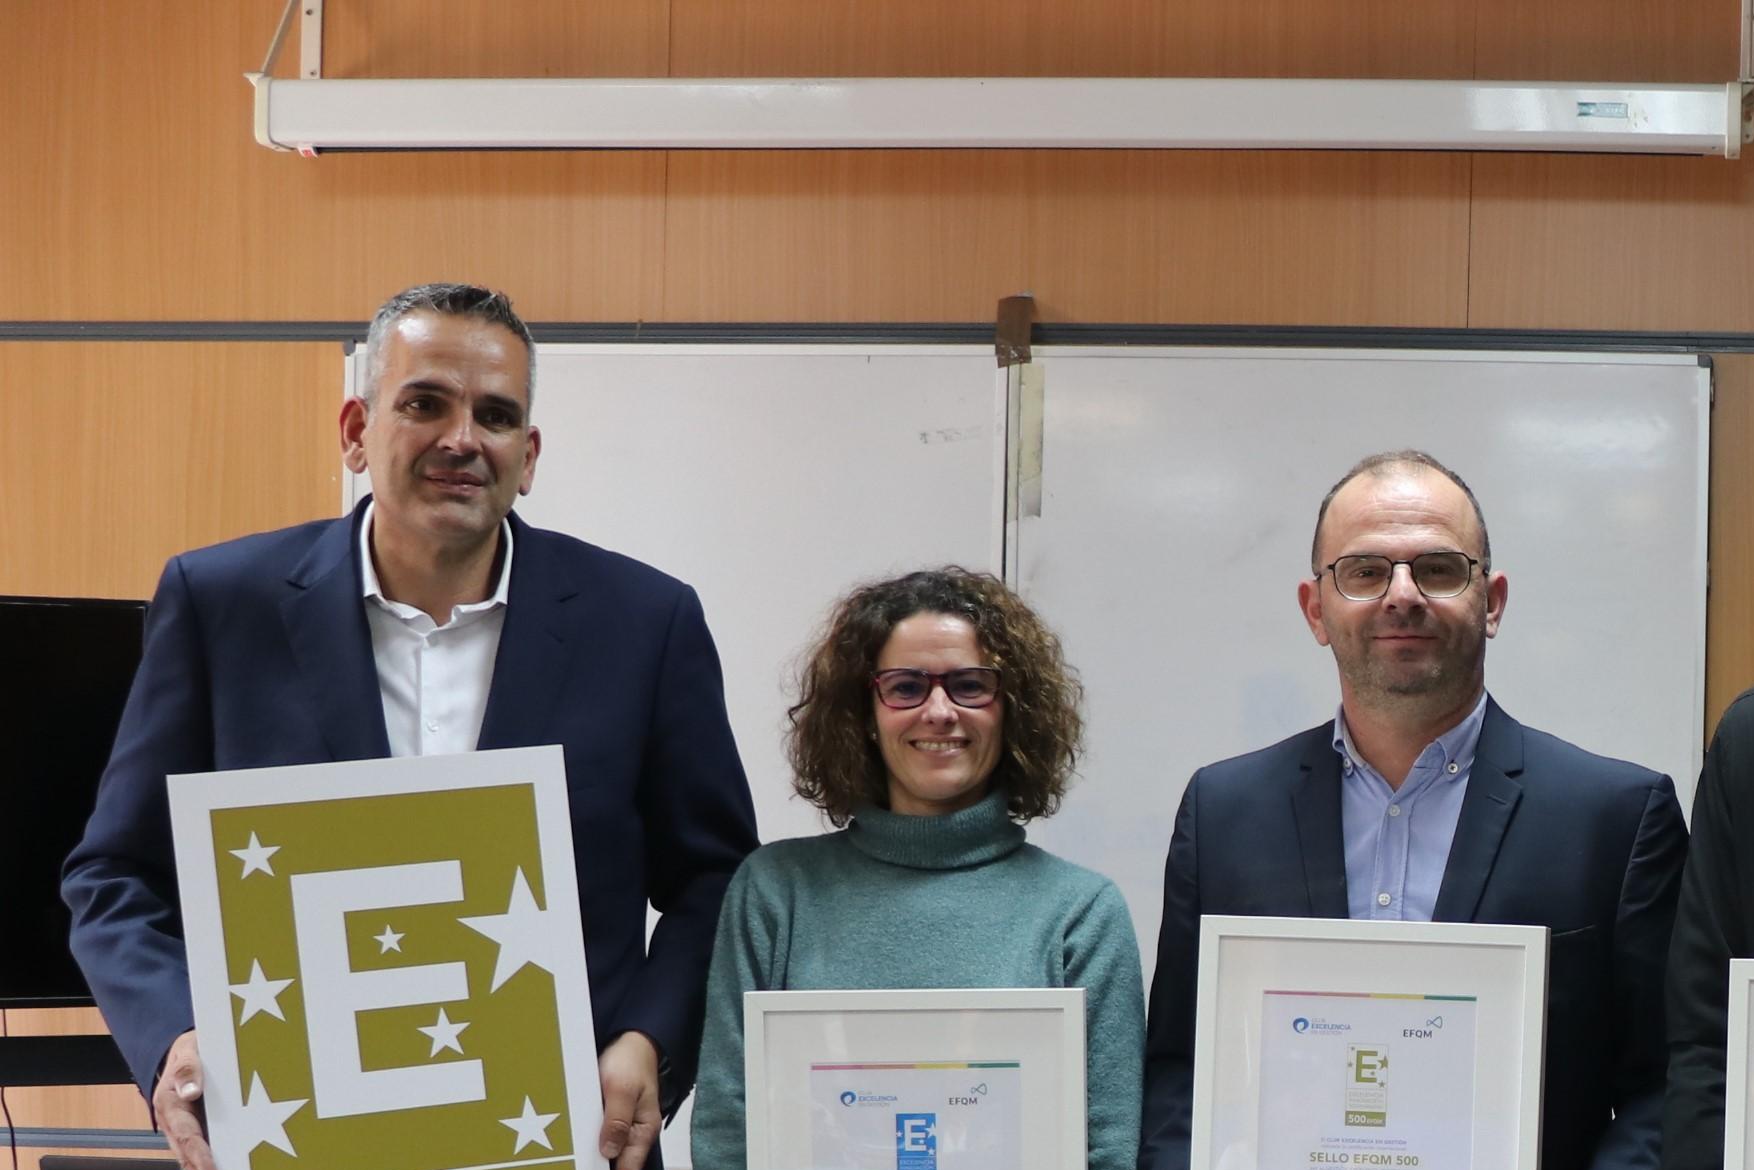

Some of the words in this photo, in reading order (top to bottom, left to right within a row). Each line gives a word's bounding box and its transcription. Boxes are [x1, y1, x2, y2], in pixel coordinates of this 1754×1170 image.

[1403, 1029, 1432, 1038] EFQM
[1348, 1115, 1366, 1123] 500
[1310, 1152, 1349, 1163] SELLO
[1354, 1154, 1392, 1165] EFQM
[1396, 1156, 1419, 1166] 500
